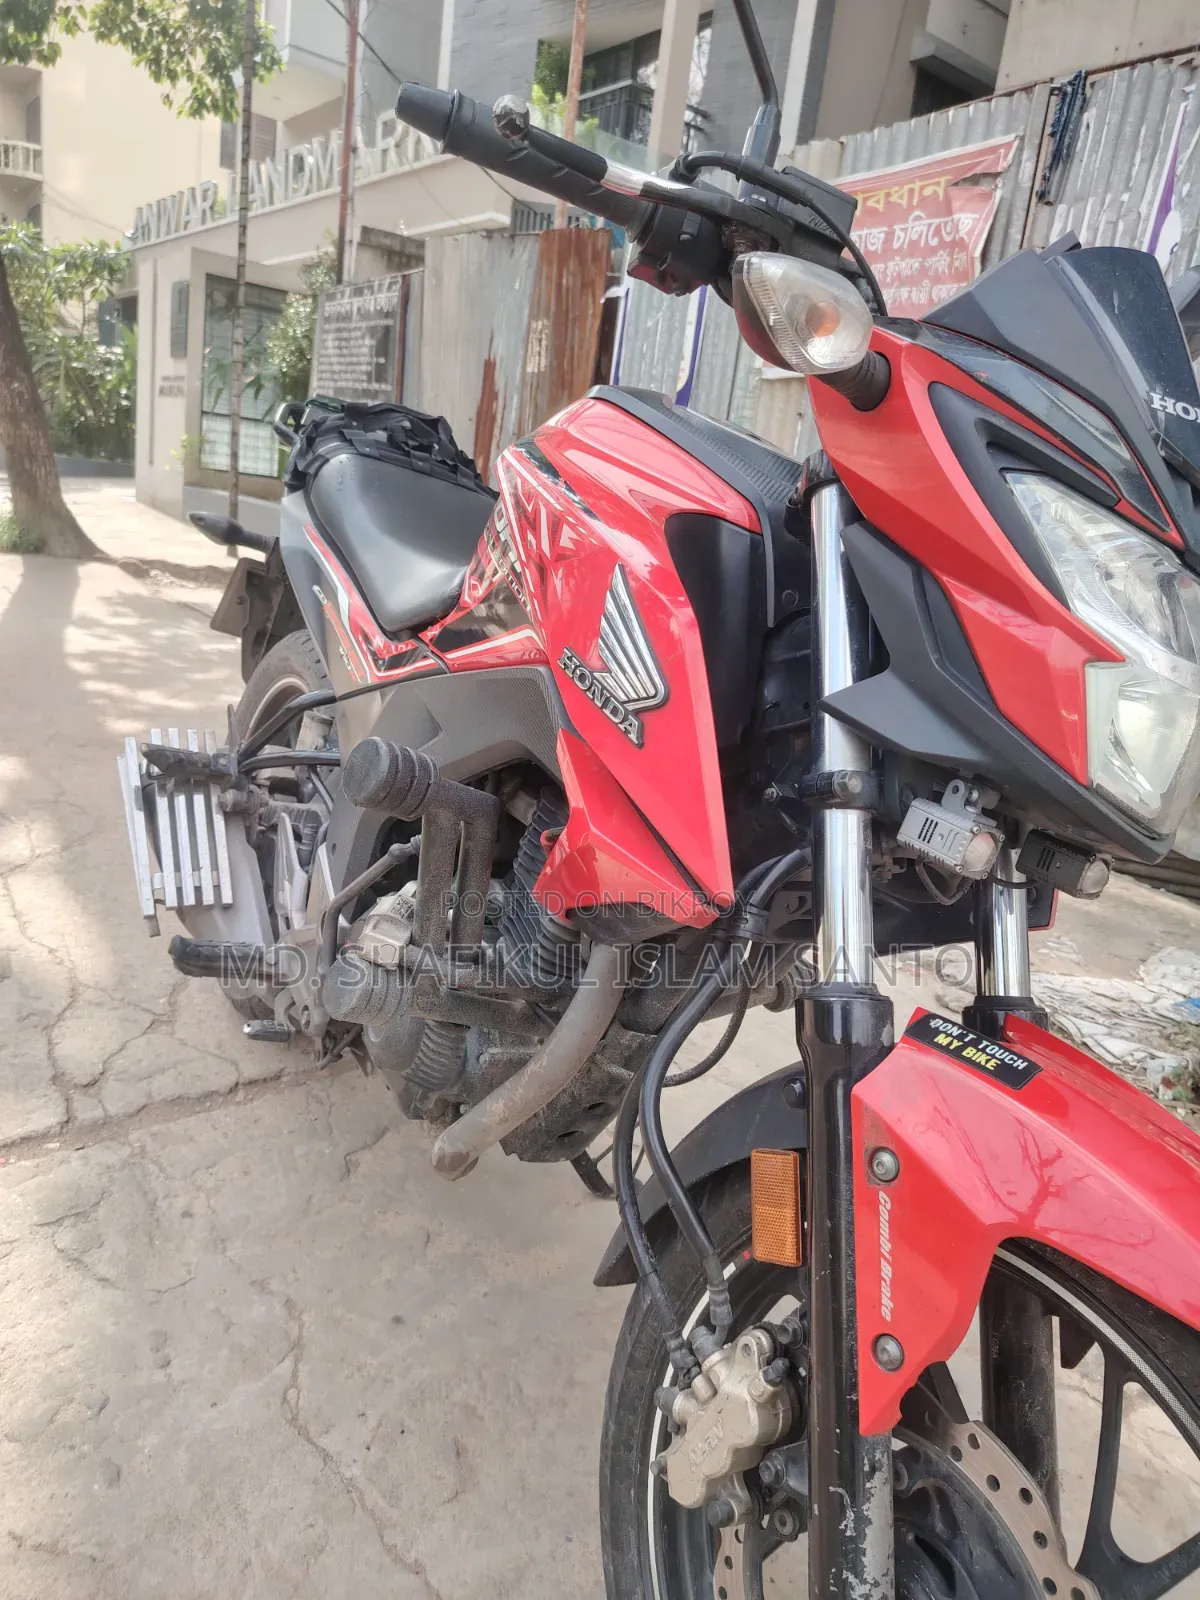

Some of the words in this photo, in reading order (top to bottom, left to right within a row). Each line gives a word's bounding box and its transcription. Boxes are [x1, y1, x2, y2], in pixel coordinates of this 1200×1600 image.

[131, 179, 219, 246] ANWAR
[557, 645, 640, 746] HONDA
[929, 1018, 977, 1042] DON'T
[977, 1039, 1029, 1070] TOUCH
[933, 1033, 963, 1050] MY
[961, 1046, 1001, 1070] BIKE
[878, 1190, 892, 1262] Combi
[880, 1257, 894, 1322] Brake
